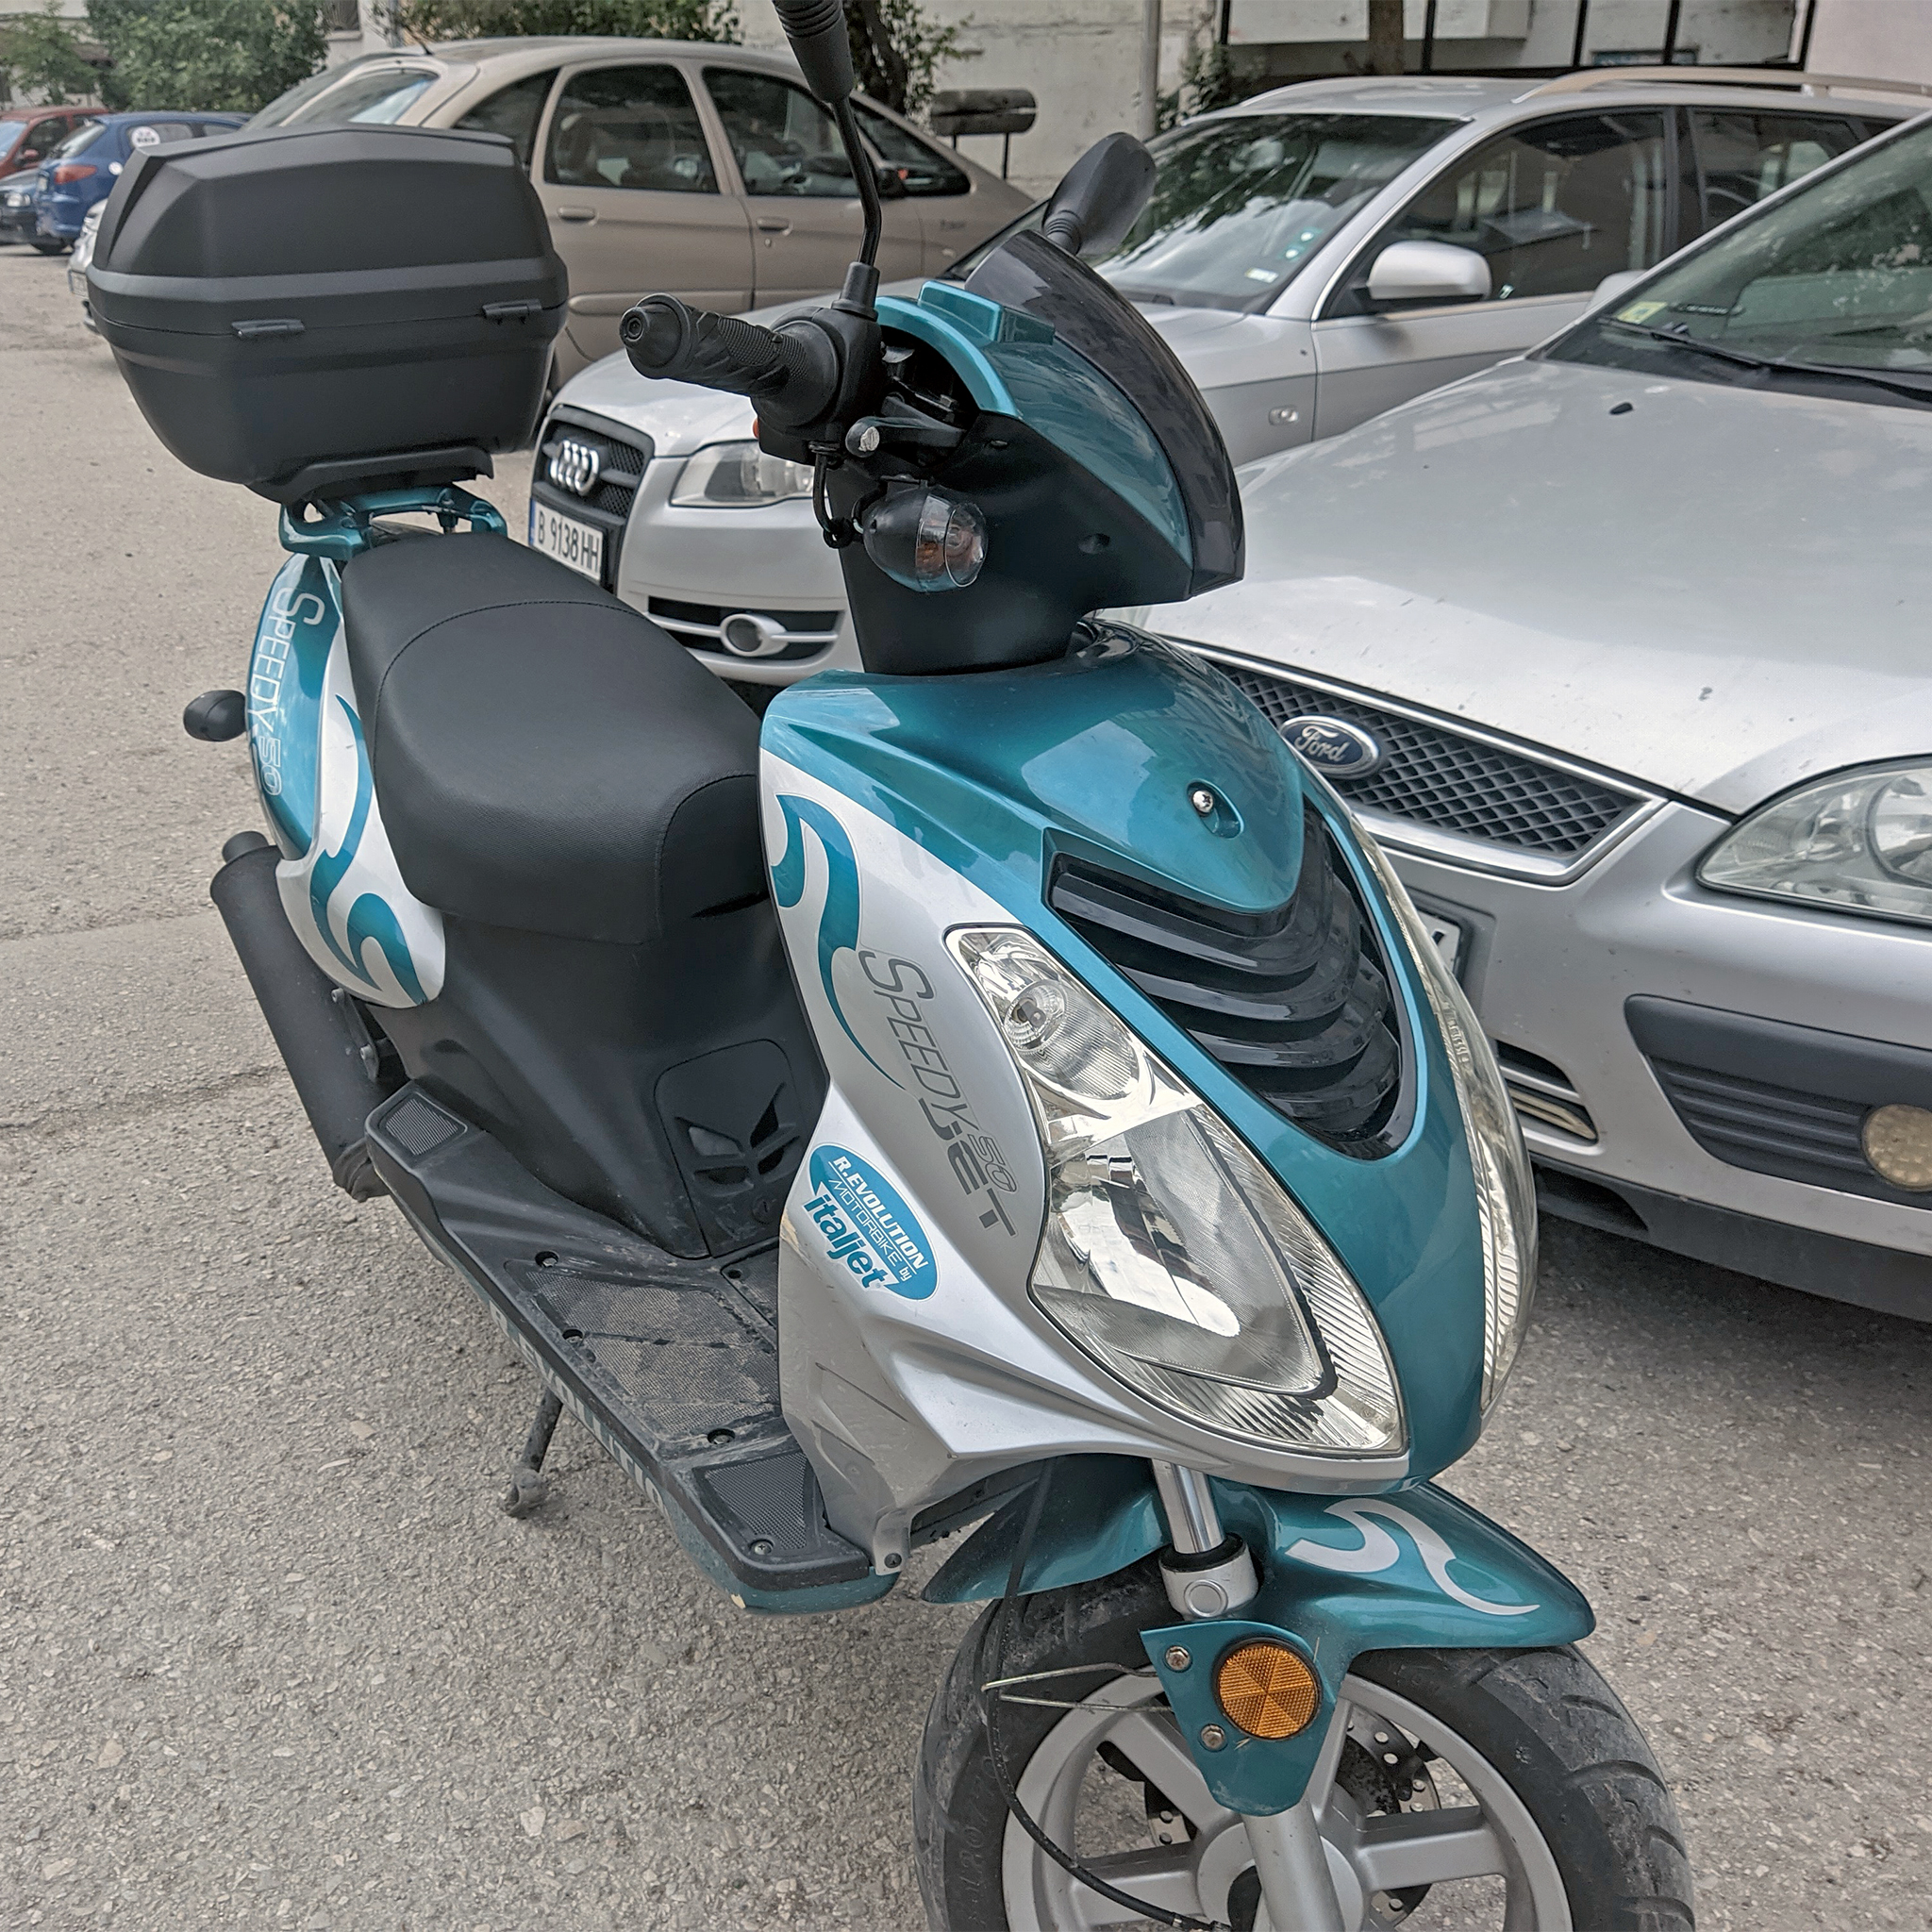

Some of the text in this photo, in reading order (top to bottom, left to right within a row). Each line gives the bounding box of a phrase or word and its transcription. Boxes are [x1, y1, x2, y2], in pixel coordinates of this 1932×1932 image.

[538, 510, 600, 574] B 9138 HH
[247, 587, 325, 796] SPEEDY 50
[1294, 724, 1351, 762] Ford
[858, 950, 1018, 1193] SPEEDY 50
[832, 1156, 929, 1270] R.EVOLUTION
[918, 1097, 1016, 1238] JET
[804, 1193, 889, 1289] italjet
[828, 1179, 912, 1282] MOTORBIKE by
[489, 1299, 673, 1524] R.EVOLUTIO
